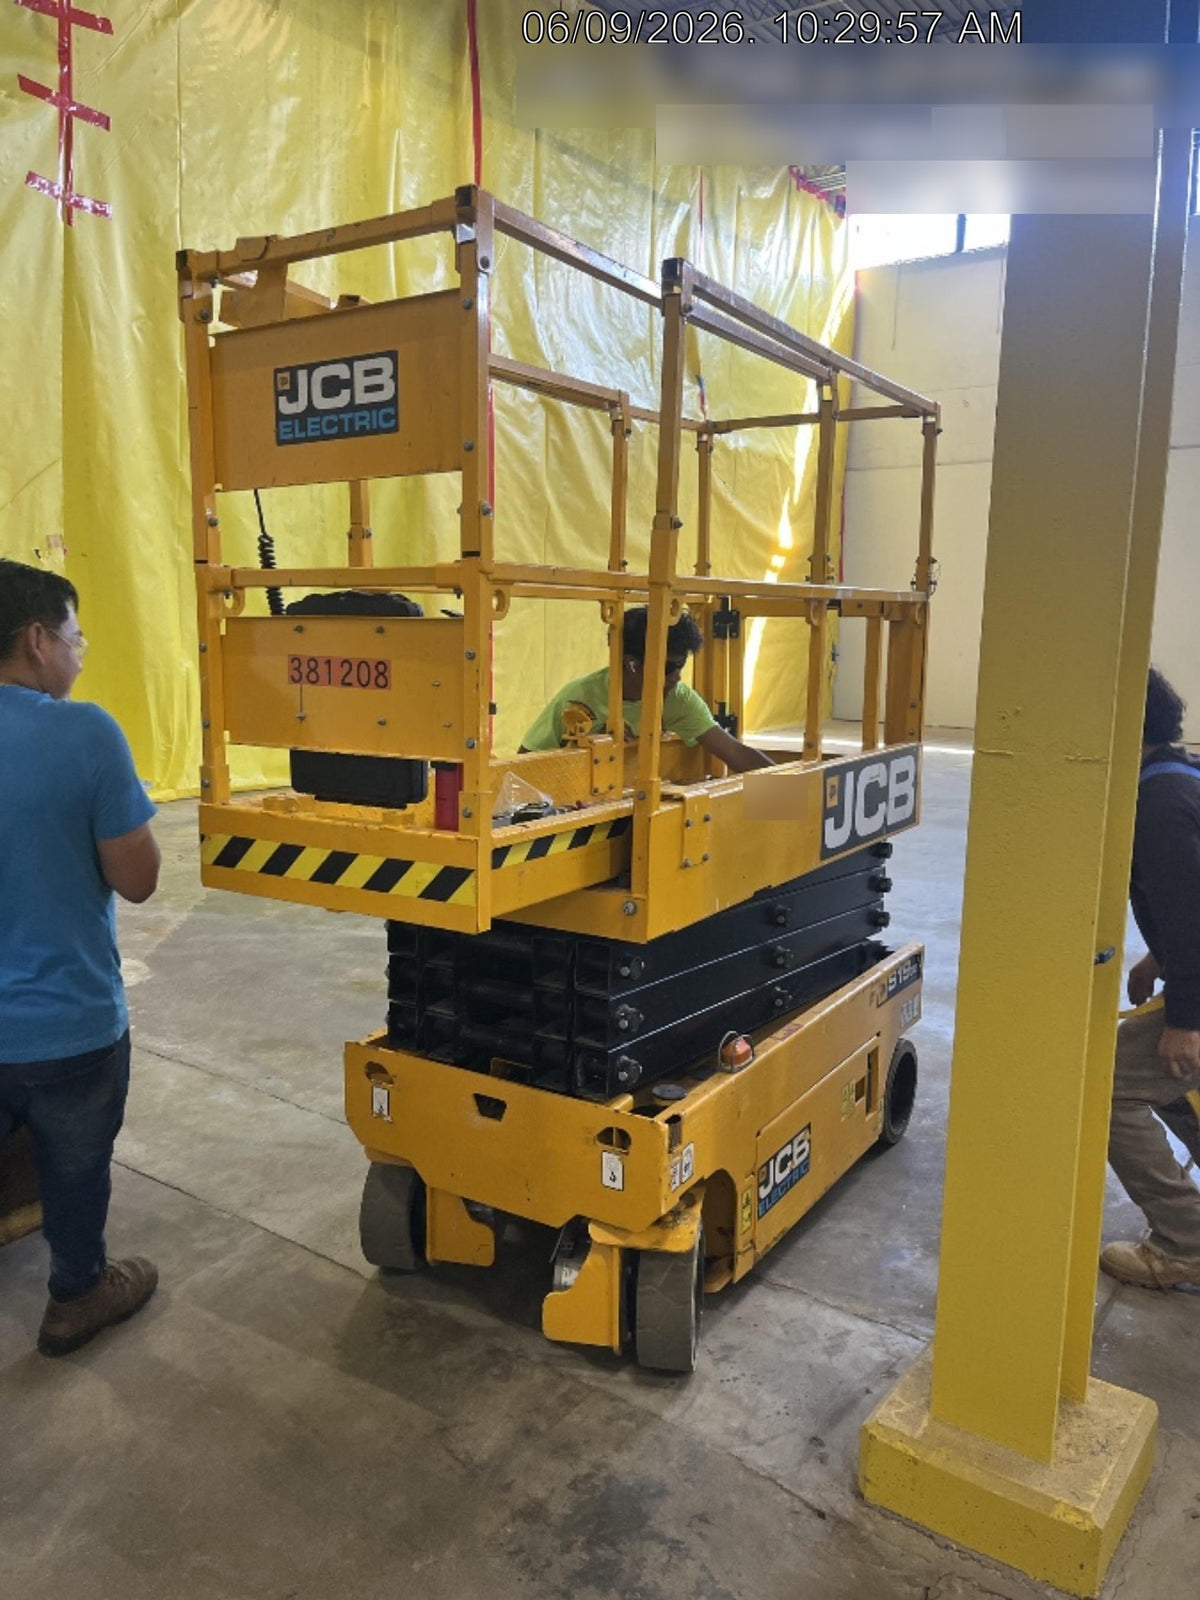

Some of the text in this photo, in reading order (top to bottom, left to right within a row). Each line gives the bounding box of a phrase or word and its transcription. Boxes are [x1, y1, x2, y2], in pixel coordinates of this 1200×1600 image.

[278, 356, 396, 415] JCB
[278, 406, 396, 440] ELECTRIC
[290, 656, 389, 689] 381208
[824, 754, 916, 849] JCB
[758, 1127, 811, 1200] JCB
